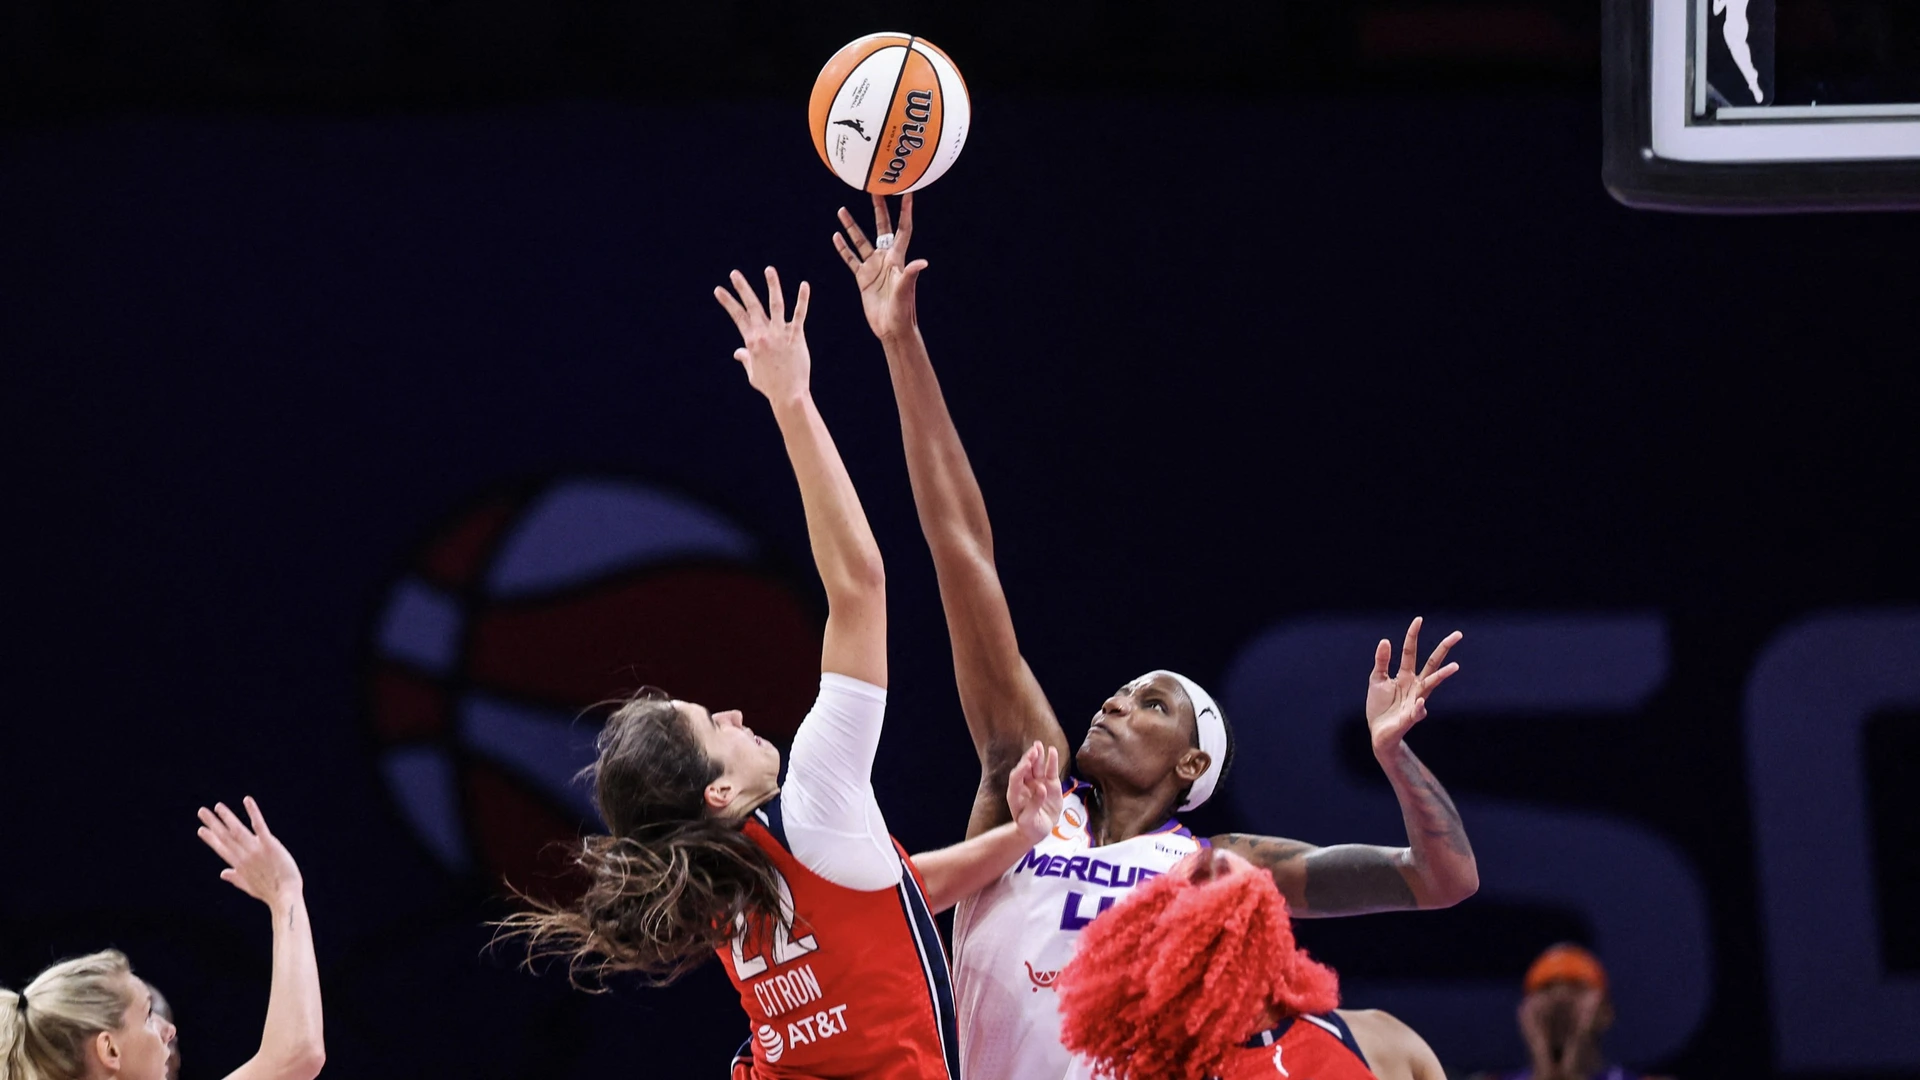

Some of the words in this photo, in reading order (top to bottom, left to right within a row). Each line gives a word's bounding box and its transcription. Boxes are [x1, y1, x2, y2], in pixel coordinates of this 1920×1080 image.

[879, 89, 933, 184] Wilson
[754, 964, 822, 1018] CITRON
[787, 1004, 848, 1049] AT&T
